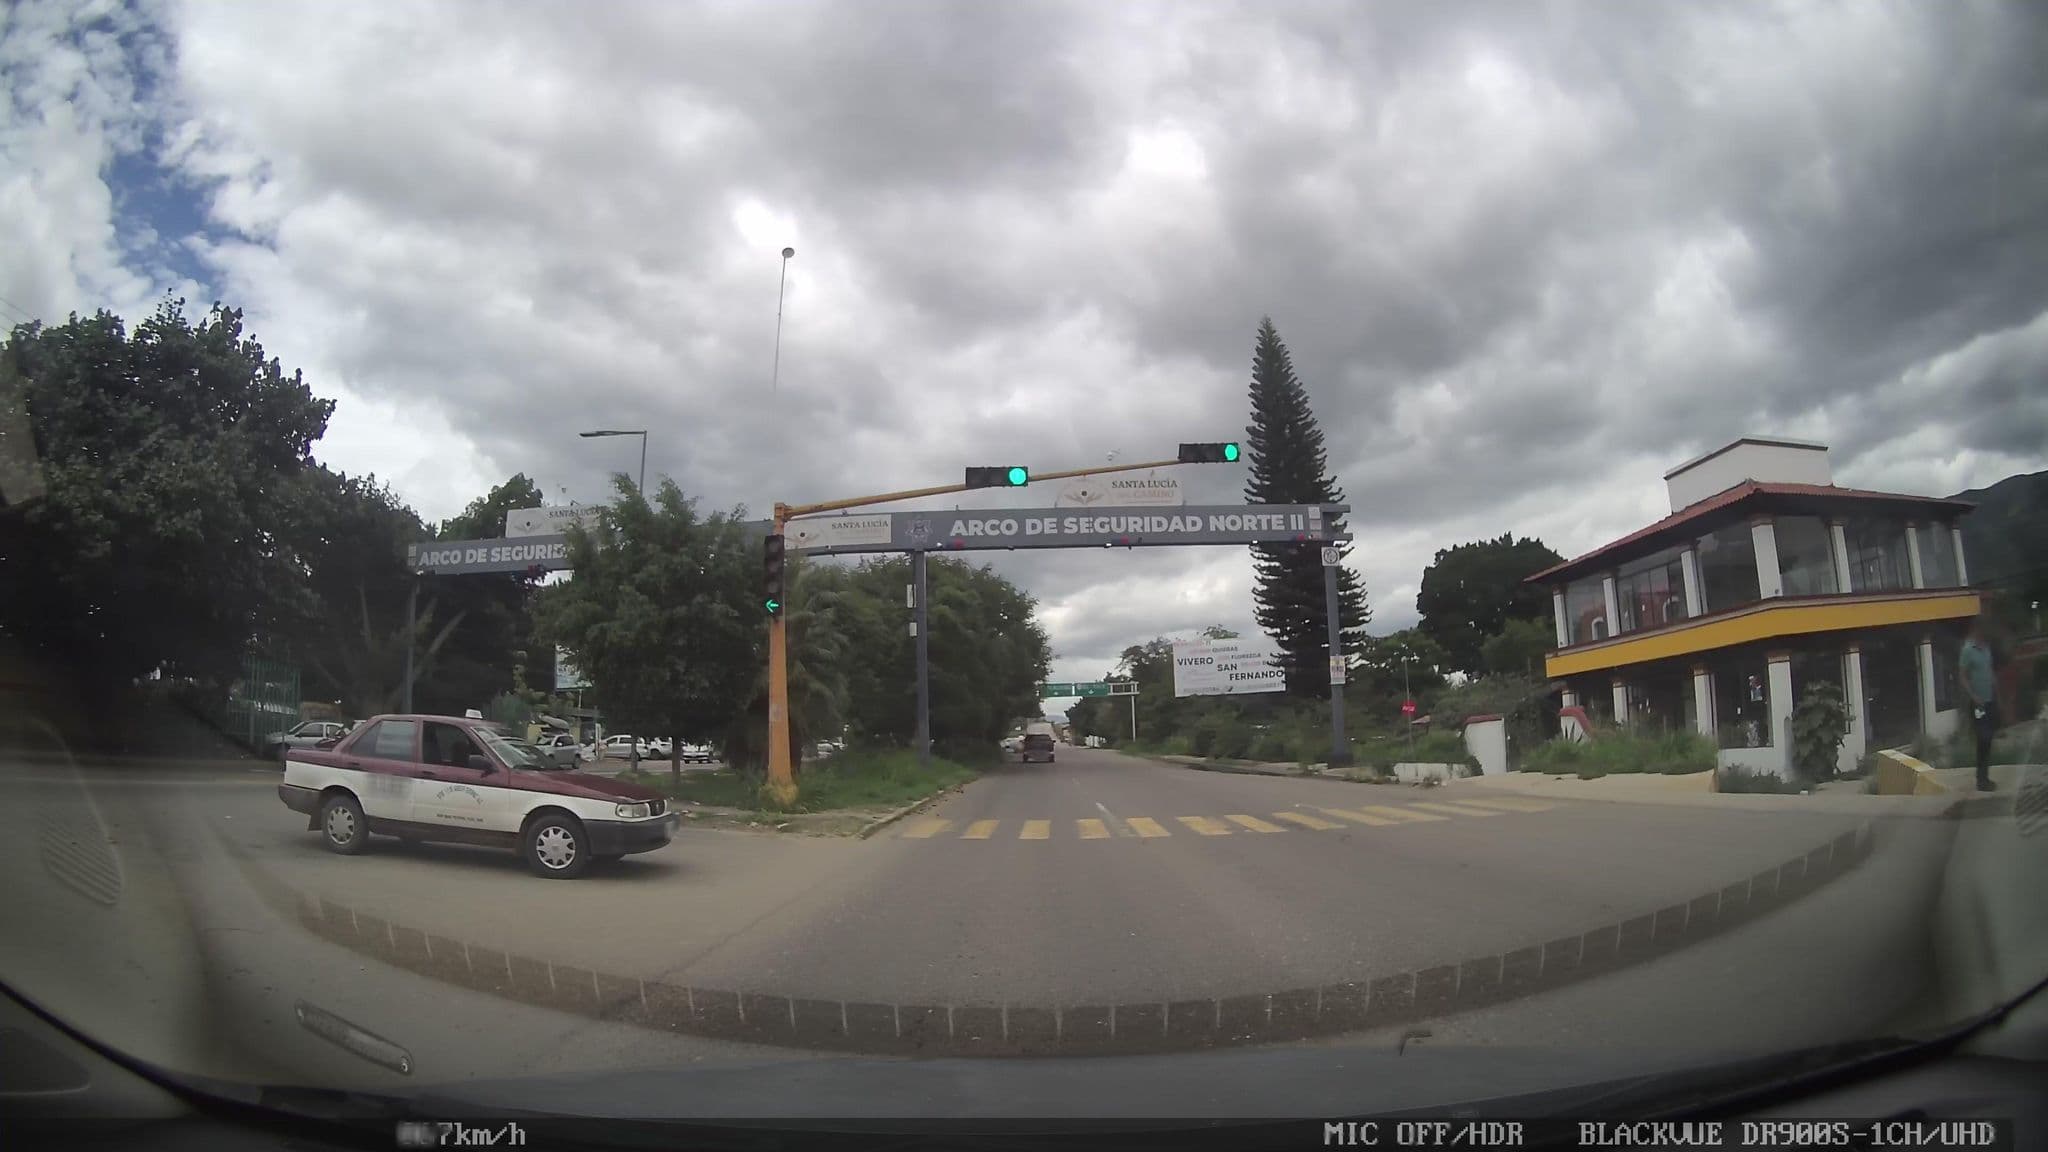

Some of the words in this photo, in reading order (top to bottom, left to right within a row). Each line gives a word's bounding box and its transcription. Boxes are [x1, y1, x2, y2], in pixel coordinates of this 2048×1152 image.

[1112, 480, 1145, 489] SANTA
[831, 521, 861, 529] SANTA
[950, 518, 1018, 537] ARCO
[1025, 517, 1058, 535] DE
[1064, 514, 1203, 534] SEGURIDAD
[1209, 514, 1285, 532] NORTE
[1290, 514, 1304, 531] II
[419, 550, 462, 567] ARCO
[465, 548, 488, 564] DE
[490, 544, 568, 562] SEGURID
[1177, 657, 1214, 666] VIVERO
[1217, 663, 1238, 672] SAN
[1229, 669, 1284, 681] FERNANDO
